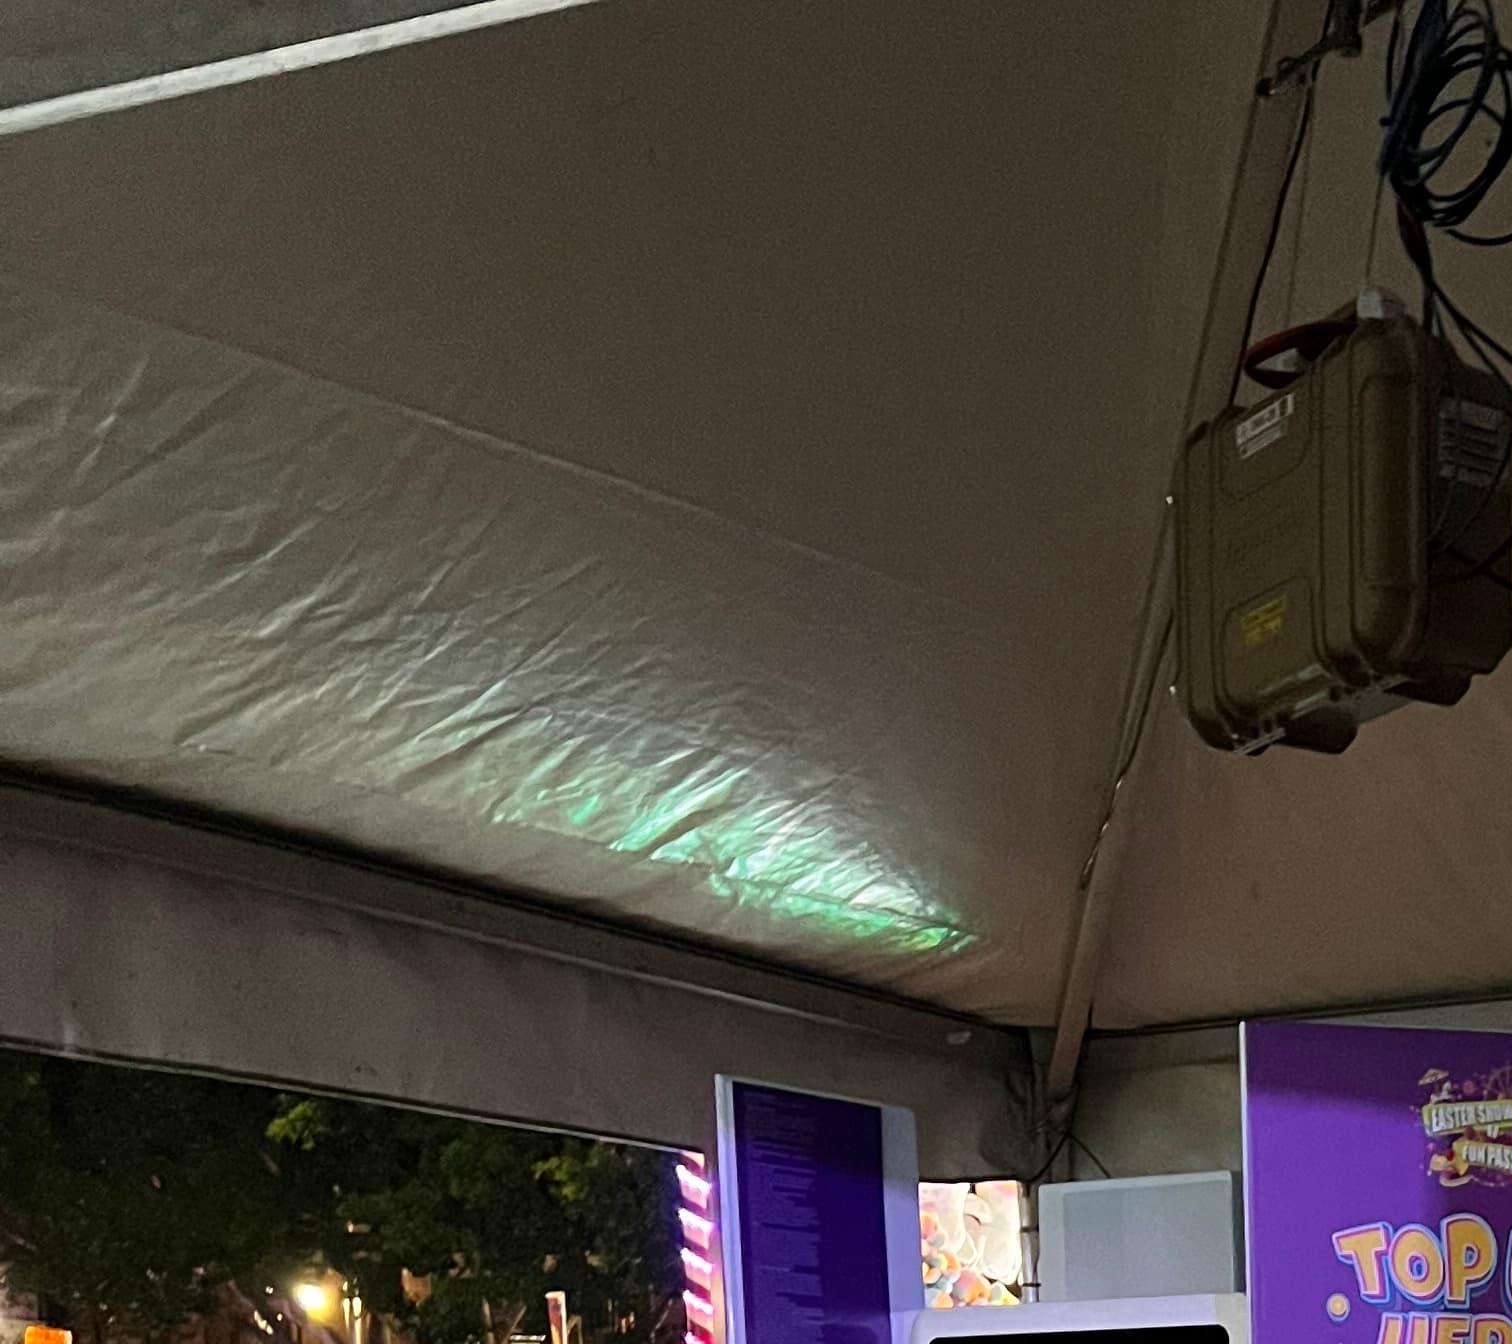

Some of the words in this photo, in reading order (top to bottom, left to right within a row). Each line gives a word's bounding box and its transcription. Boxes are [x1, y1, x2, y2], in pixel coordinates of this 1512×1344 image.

[1432, 1103, 1476, 1132] EASTER
[1462, 1144, 1486, 1164] FUN
[1332, 1213, 1498, 1308] TOP
